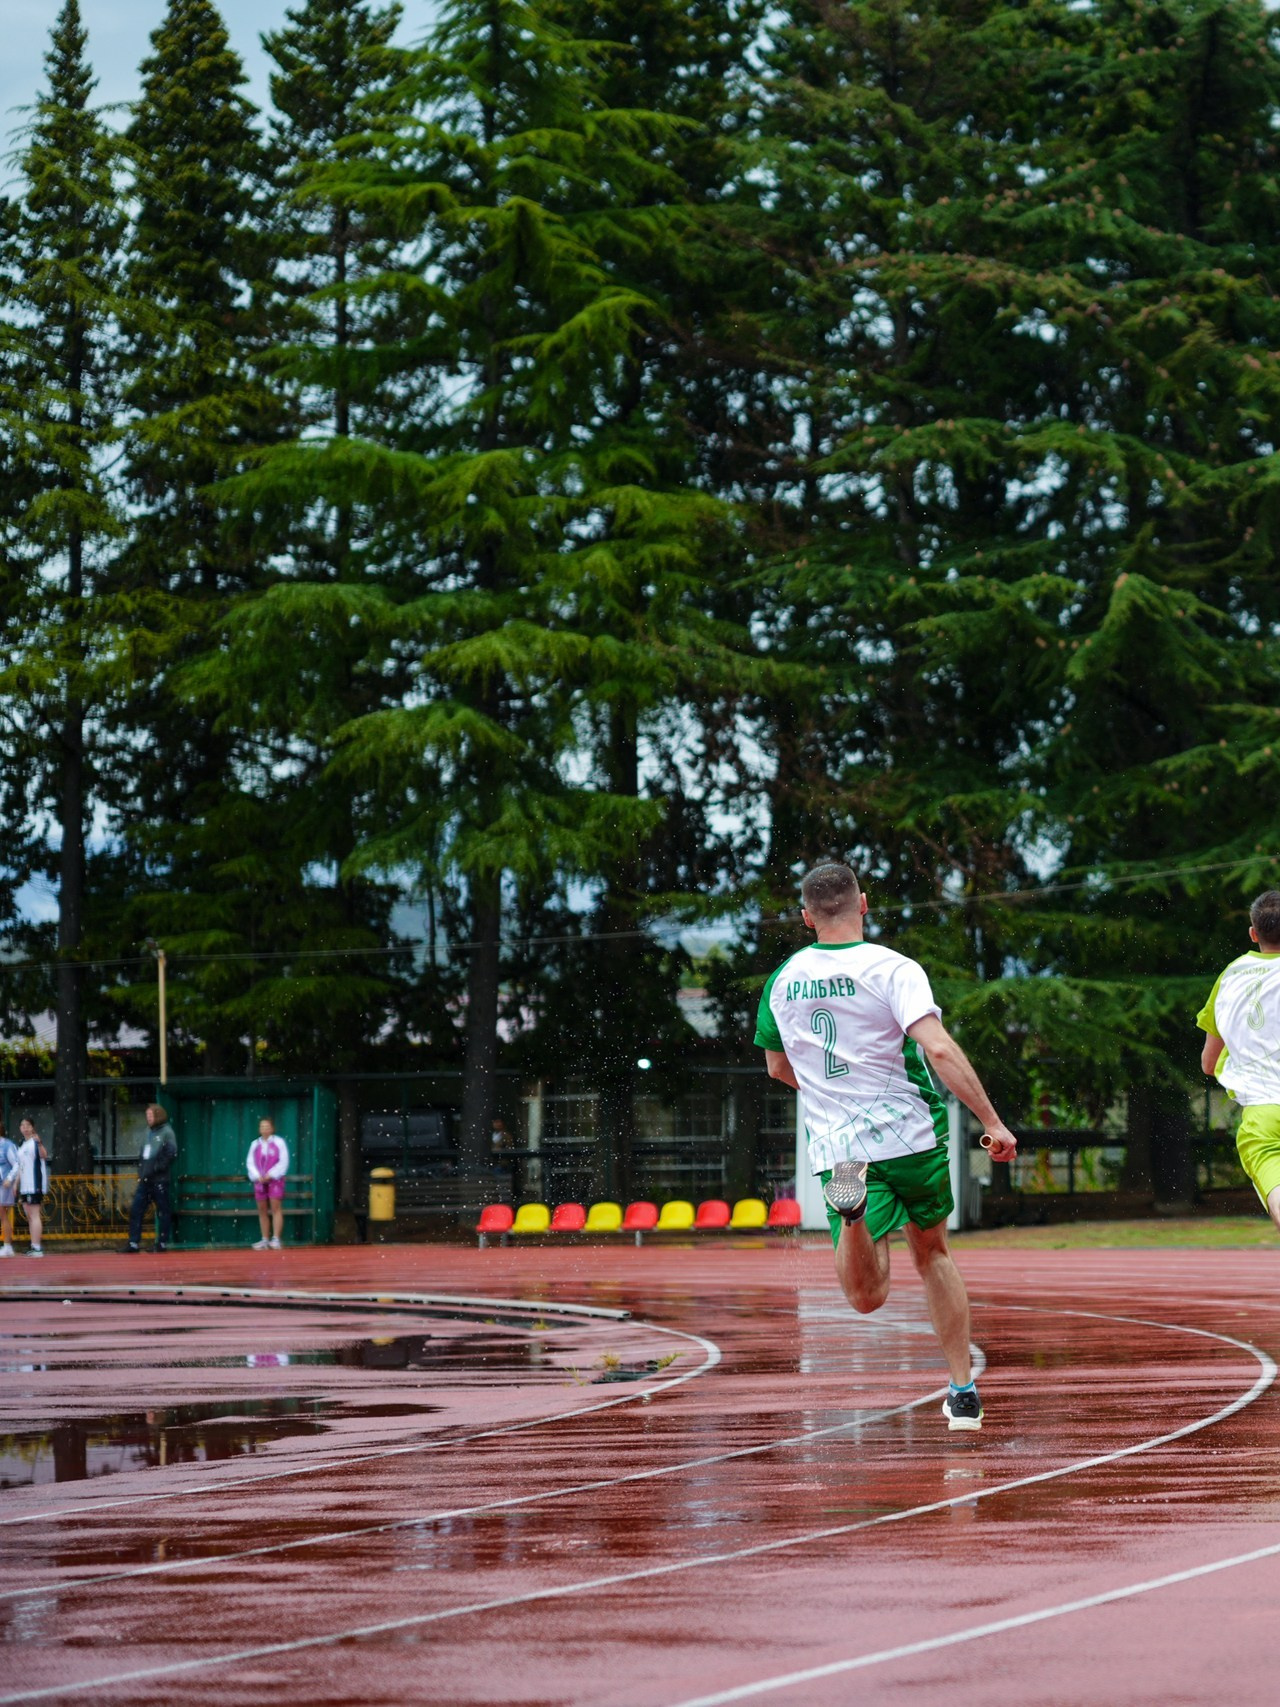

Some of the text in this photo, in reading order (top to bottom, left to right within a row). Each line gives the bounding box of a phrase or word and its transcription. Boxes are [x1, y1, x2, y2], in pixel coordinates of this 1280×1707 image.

[786, 977, 856, 1001] АРАЛБАЕВ
[811, 1008, 849, 1079] 2
[839, 1133, 858, 1162] 2
[863, 1117, 885, 1145] 3
